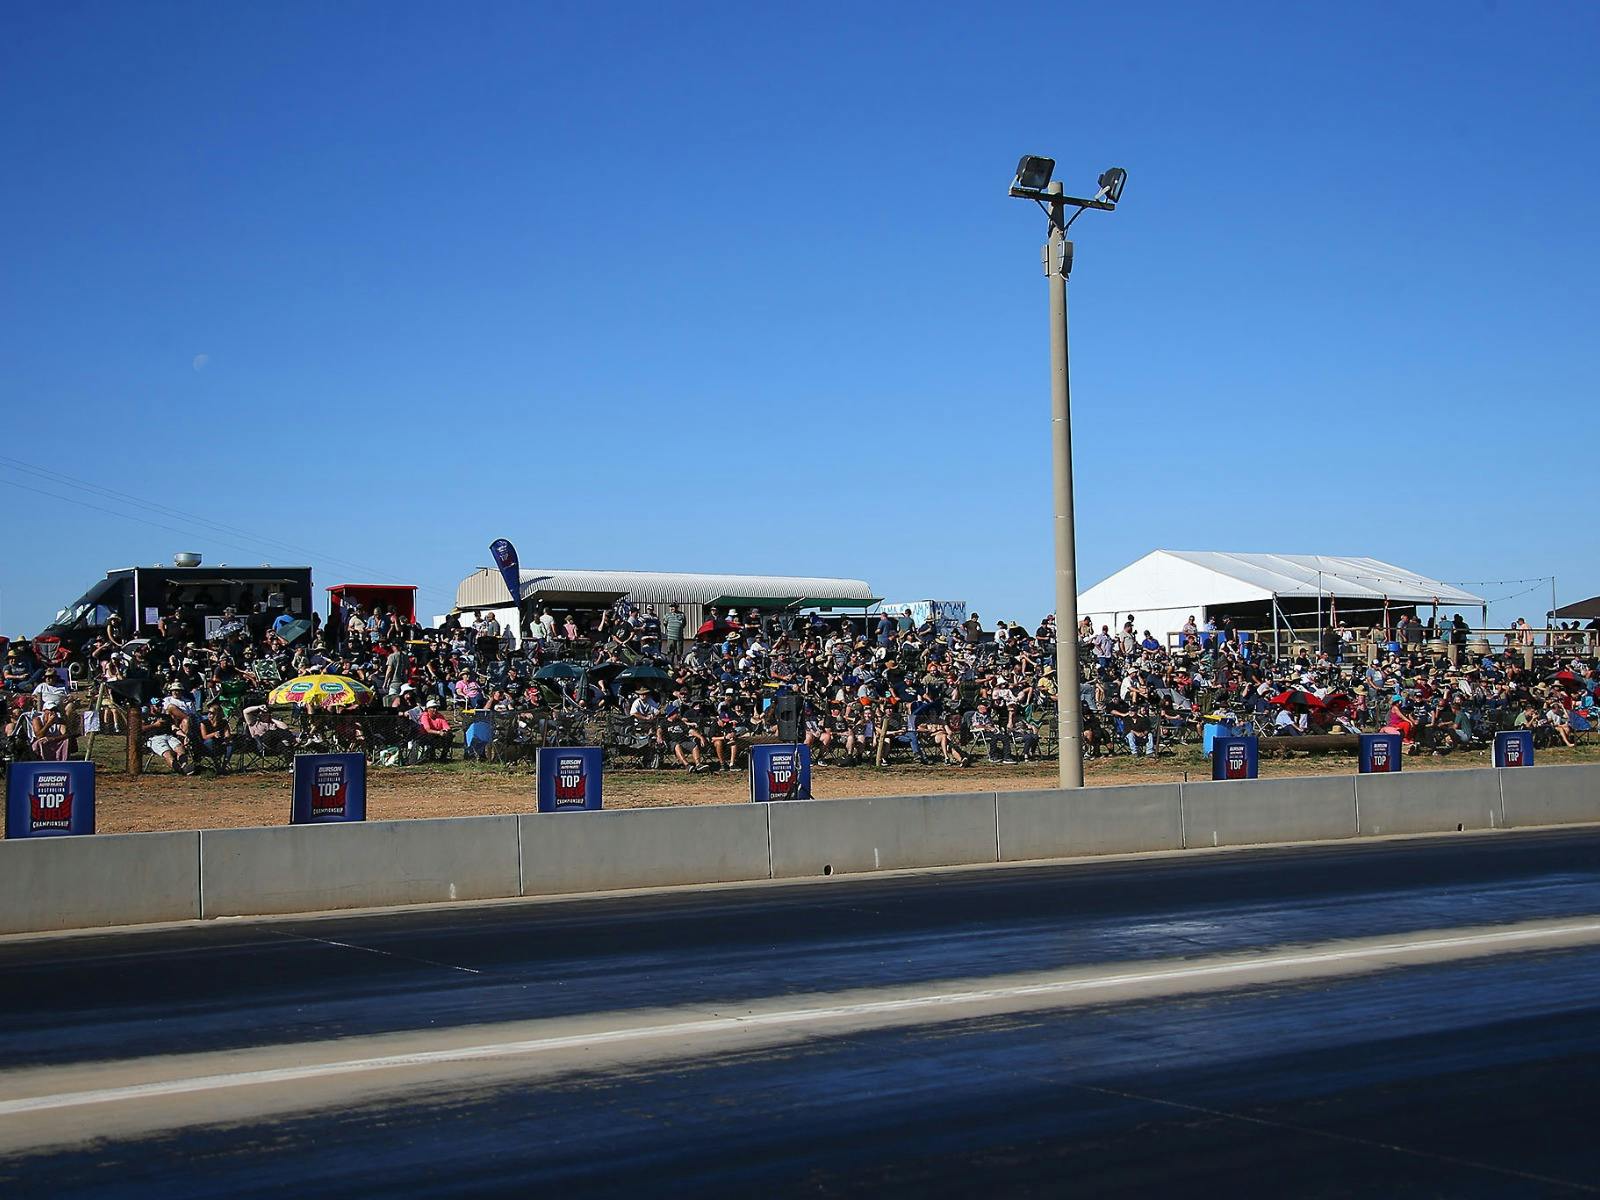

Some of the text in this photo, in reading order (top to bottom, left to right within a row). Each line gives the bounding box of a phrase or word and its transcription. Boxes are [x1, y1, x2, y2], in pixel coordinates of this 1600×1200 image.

[1374, 756, 1386, 765] TOP
[1507, 752, 1519, 761] TOP
[1230, 760, 1242, 770] TOP
[560, 776, 580, 788] TOP
[773, 771, 791, 782] TOP
[318, 783, 340, 796] TOP
[38, 794, 64, 808] TOP
